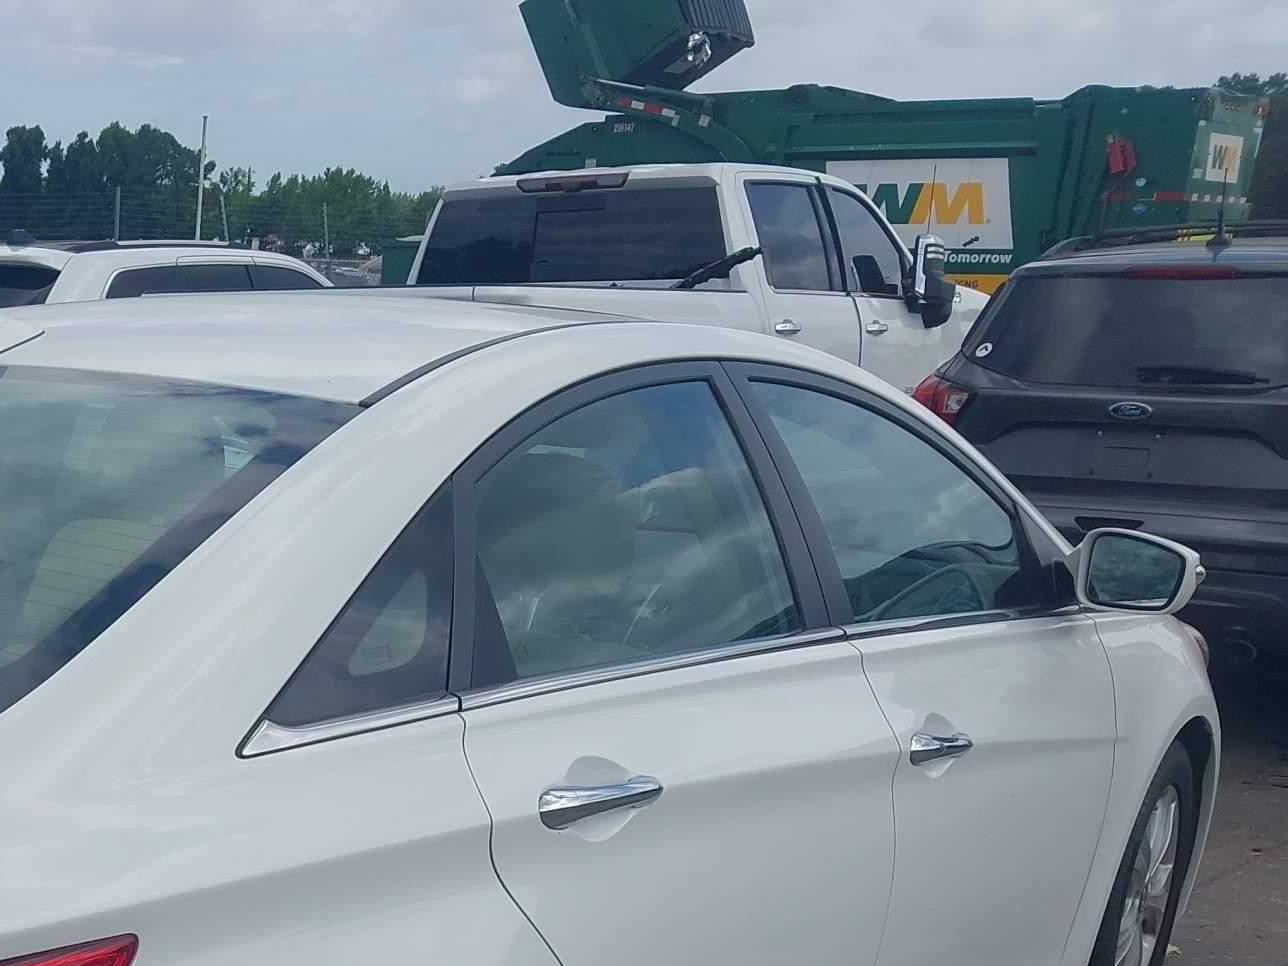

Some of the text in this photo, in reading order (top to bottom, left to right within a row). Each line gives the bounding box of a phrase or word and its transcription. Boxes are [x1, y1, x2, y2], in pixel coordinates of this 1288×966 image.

[1212, 144, 1238, 171] WM
[853, 182, 985, 225] WM
[943, 250, 1012, 264] Tomorrow
